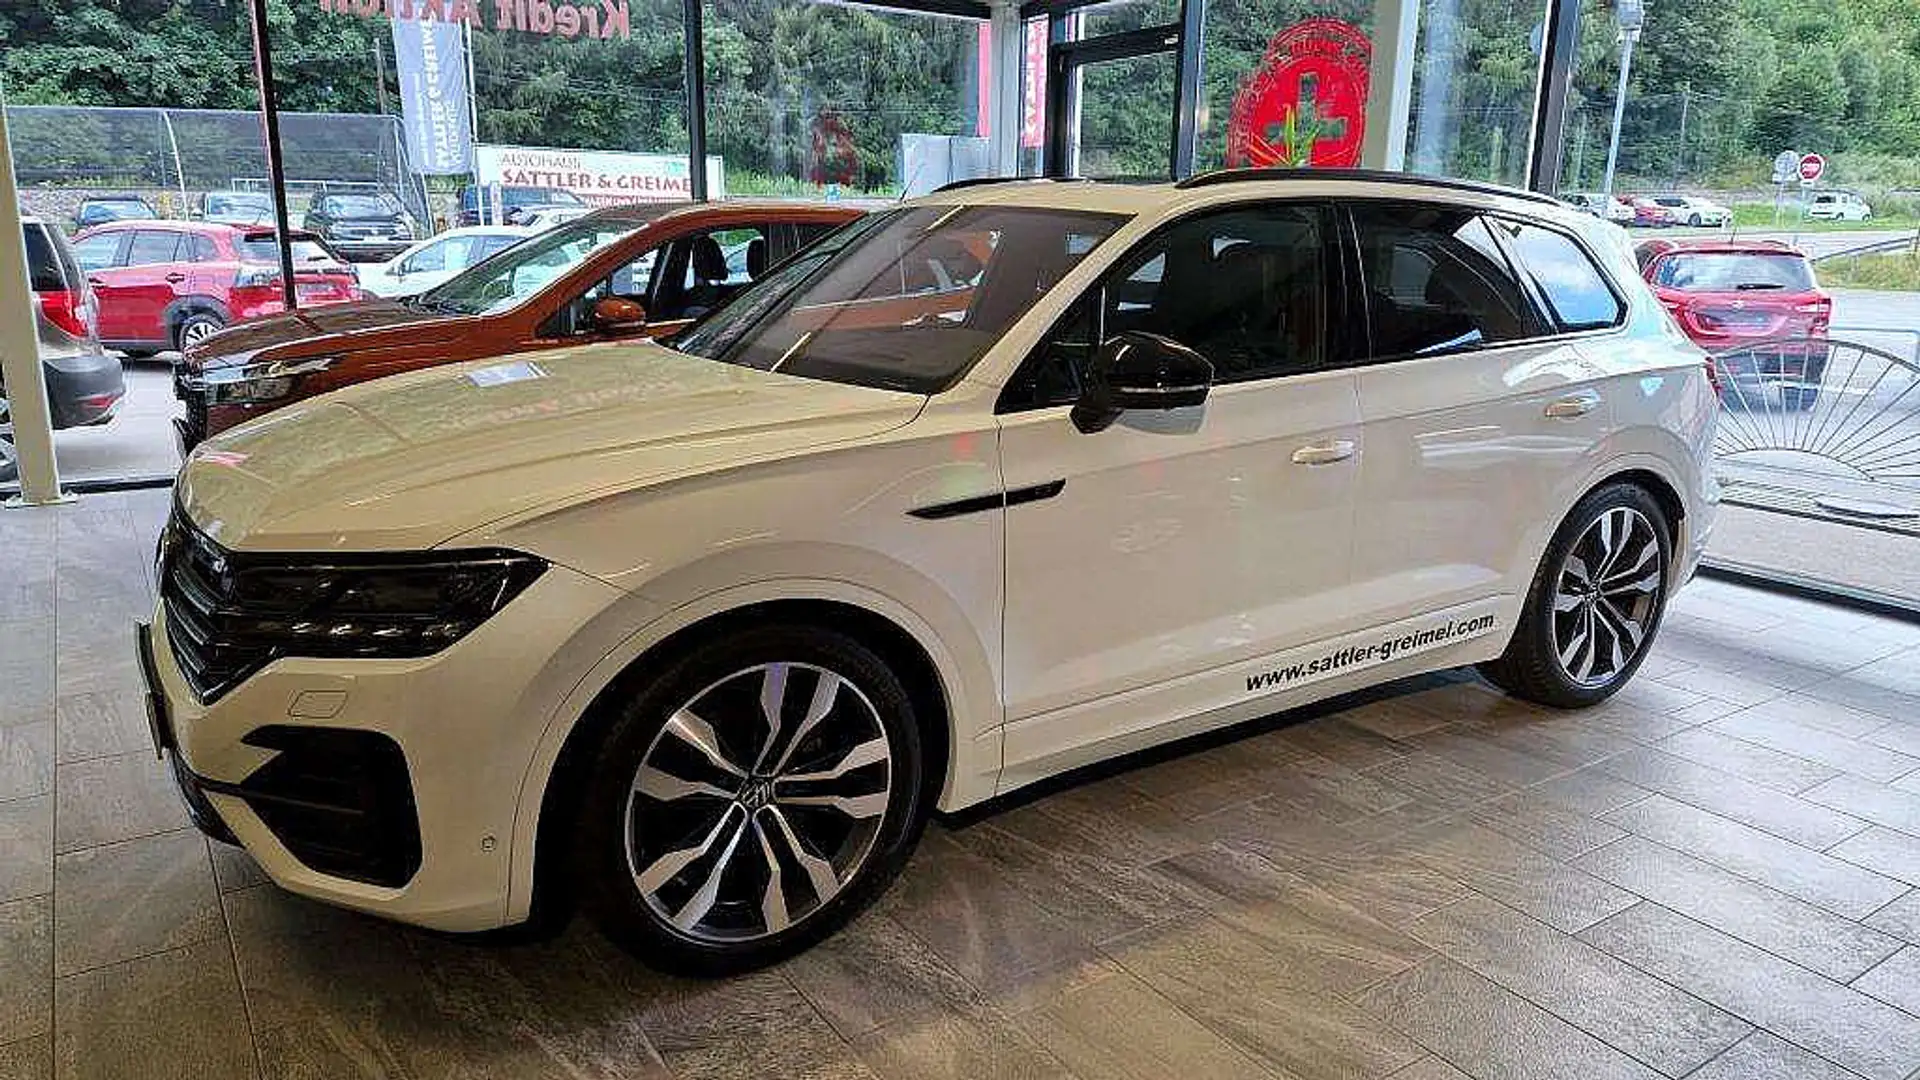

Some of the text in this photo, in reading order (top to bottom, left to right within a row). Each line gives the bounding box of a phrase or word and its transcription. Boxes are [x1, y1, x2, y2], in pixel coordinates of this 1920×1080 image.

[502, 168, 692, 193] SATTLER & GREIME
[1245, 614, 1495, 692] www.sattler-greimel.com
